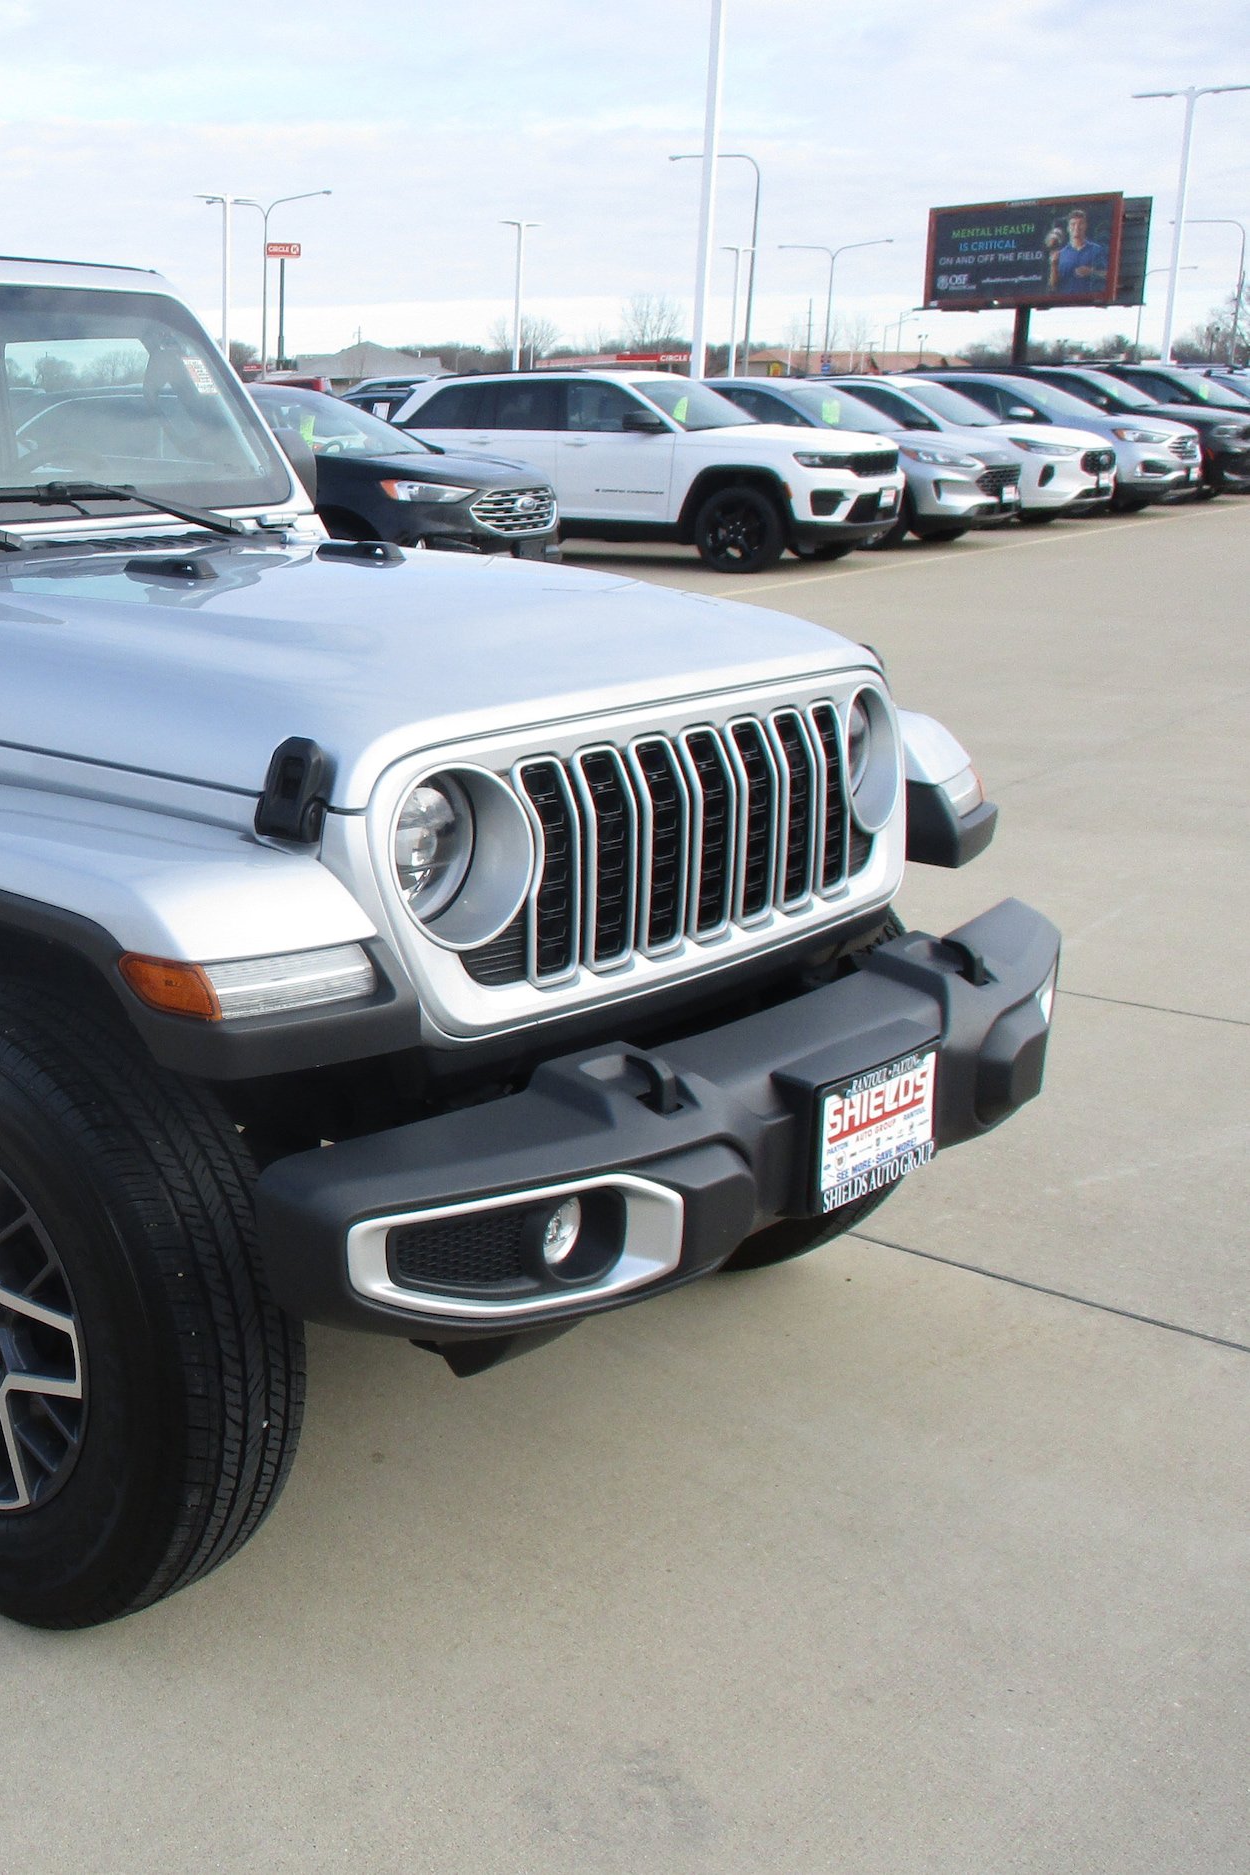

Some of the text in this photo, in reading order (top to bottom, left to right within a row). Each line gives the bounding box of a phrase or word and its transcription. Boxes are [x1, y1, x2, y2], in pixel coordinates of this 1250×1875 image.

[951, 223, 1035, 239] MENTAL HEALTH
[959, 239, 1017, 252] IS CRITICAL
[939, 249, 1043, 266] ON AND OFF THE FIELD
[660, 354, 687, 362] CIRCLE
[852, 1055, 918, 1093] RANTOUL PAXTON
[827, 1066, 929, 1140] SHIELDS
[855, 1118, 897, 1142] AUTO GROUP
[826, 1141, 849, 1156] PAXTON
[836, 1168, 849, 1182] SEE
[876, 1148, 894, 1165] SAVE
[823, 1140, 934, 1213] SHIELDS AUTO GROUP
